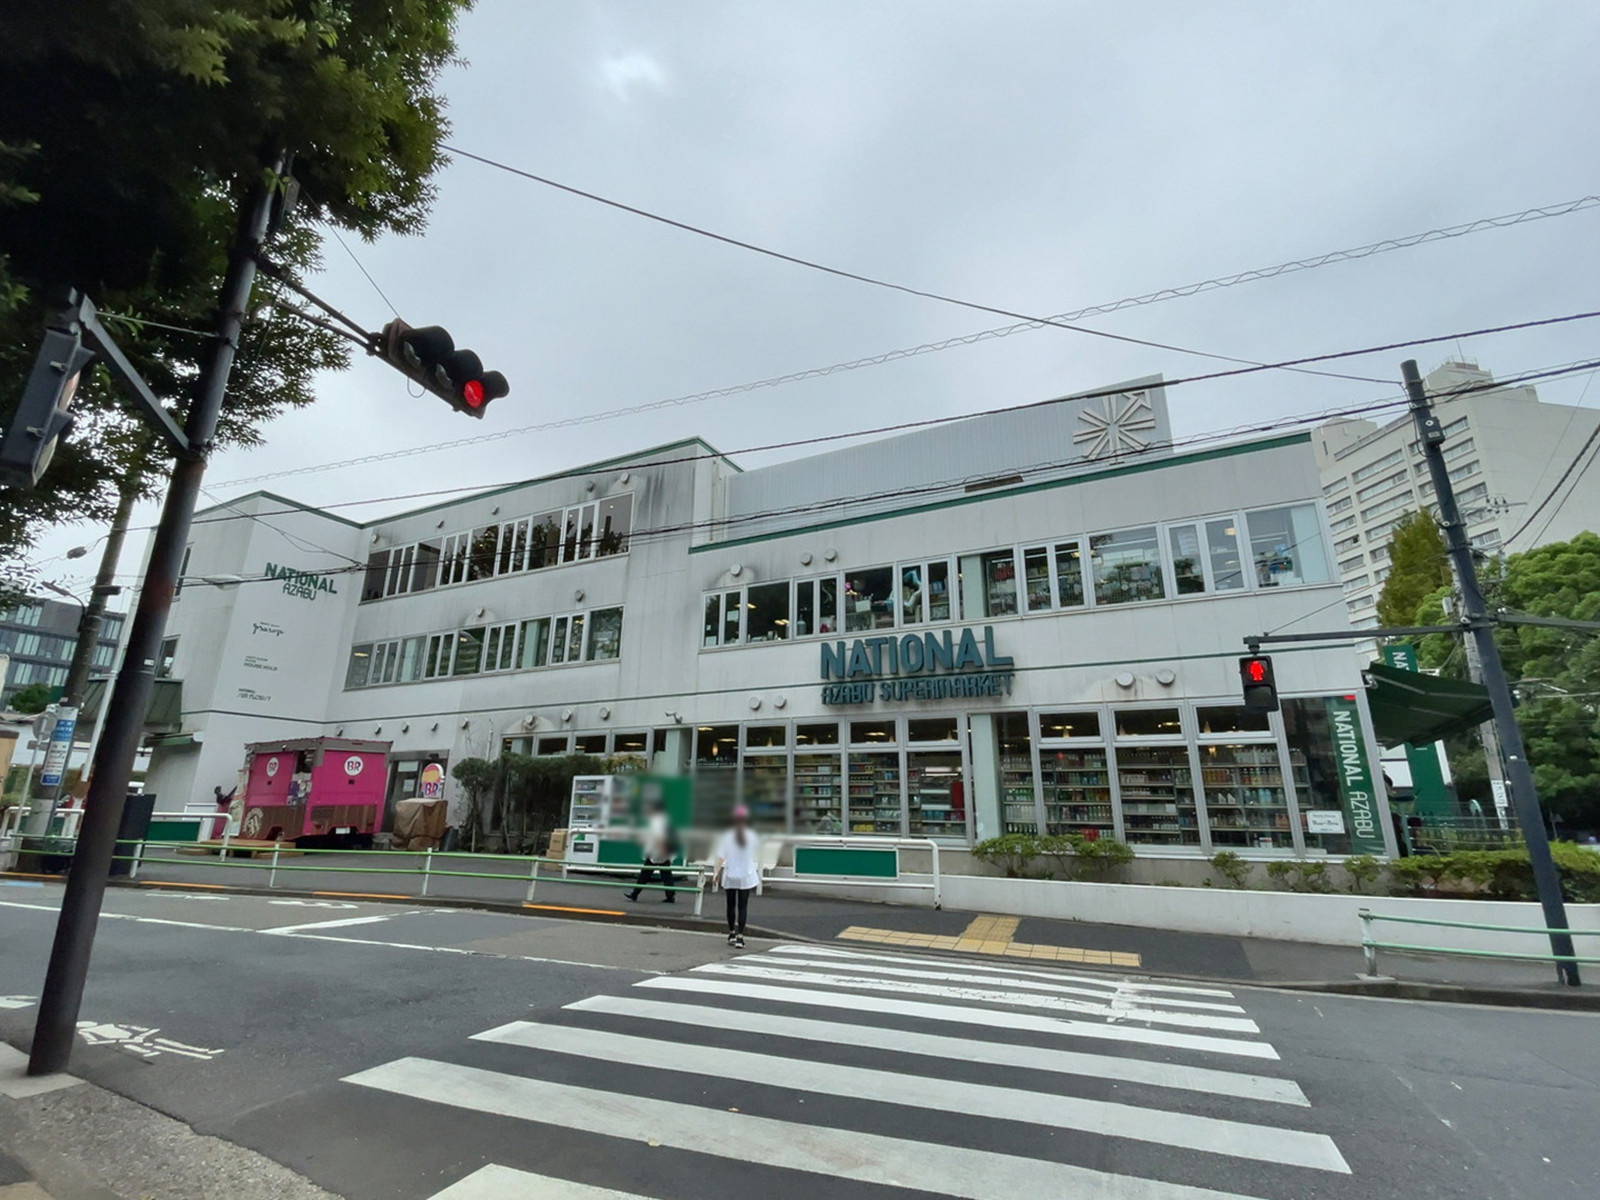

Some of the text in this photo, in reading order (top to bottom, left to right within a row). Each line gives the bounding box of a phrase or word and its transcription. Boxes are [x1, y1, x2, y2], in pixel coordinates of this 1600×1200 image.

[264, 562, 337, 594] NATIONAL
[282, 582, 317, 601] AZABU
[820, 626, 1014, 679] NATIONAL
[1391, 651, 1410, 671] NA
[821, 672, 1015, 705] AZABU SUPERMARKET
[346, 760, 362, 772] BR
[1332, 710, 1376, 839] NATIONAL AZABU
[425, 782, 439, 797] BR
